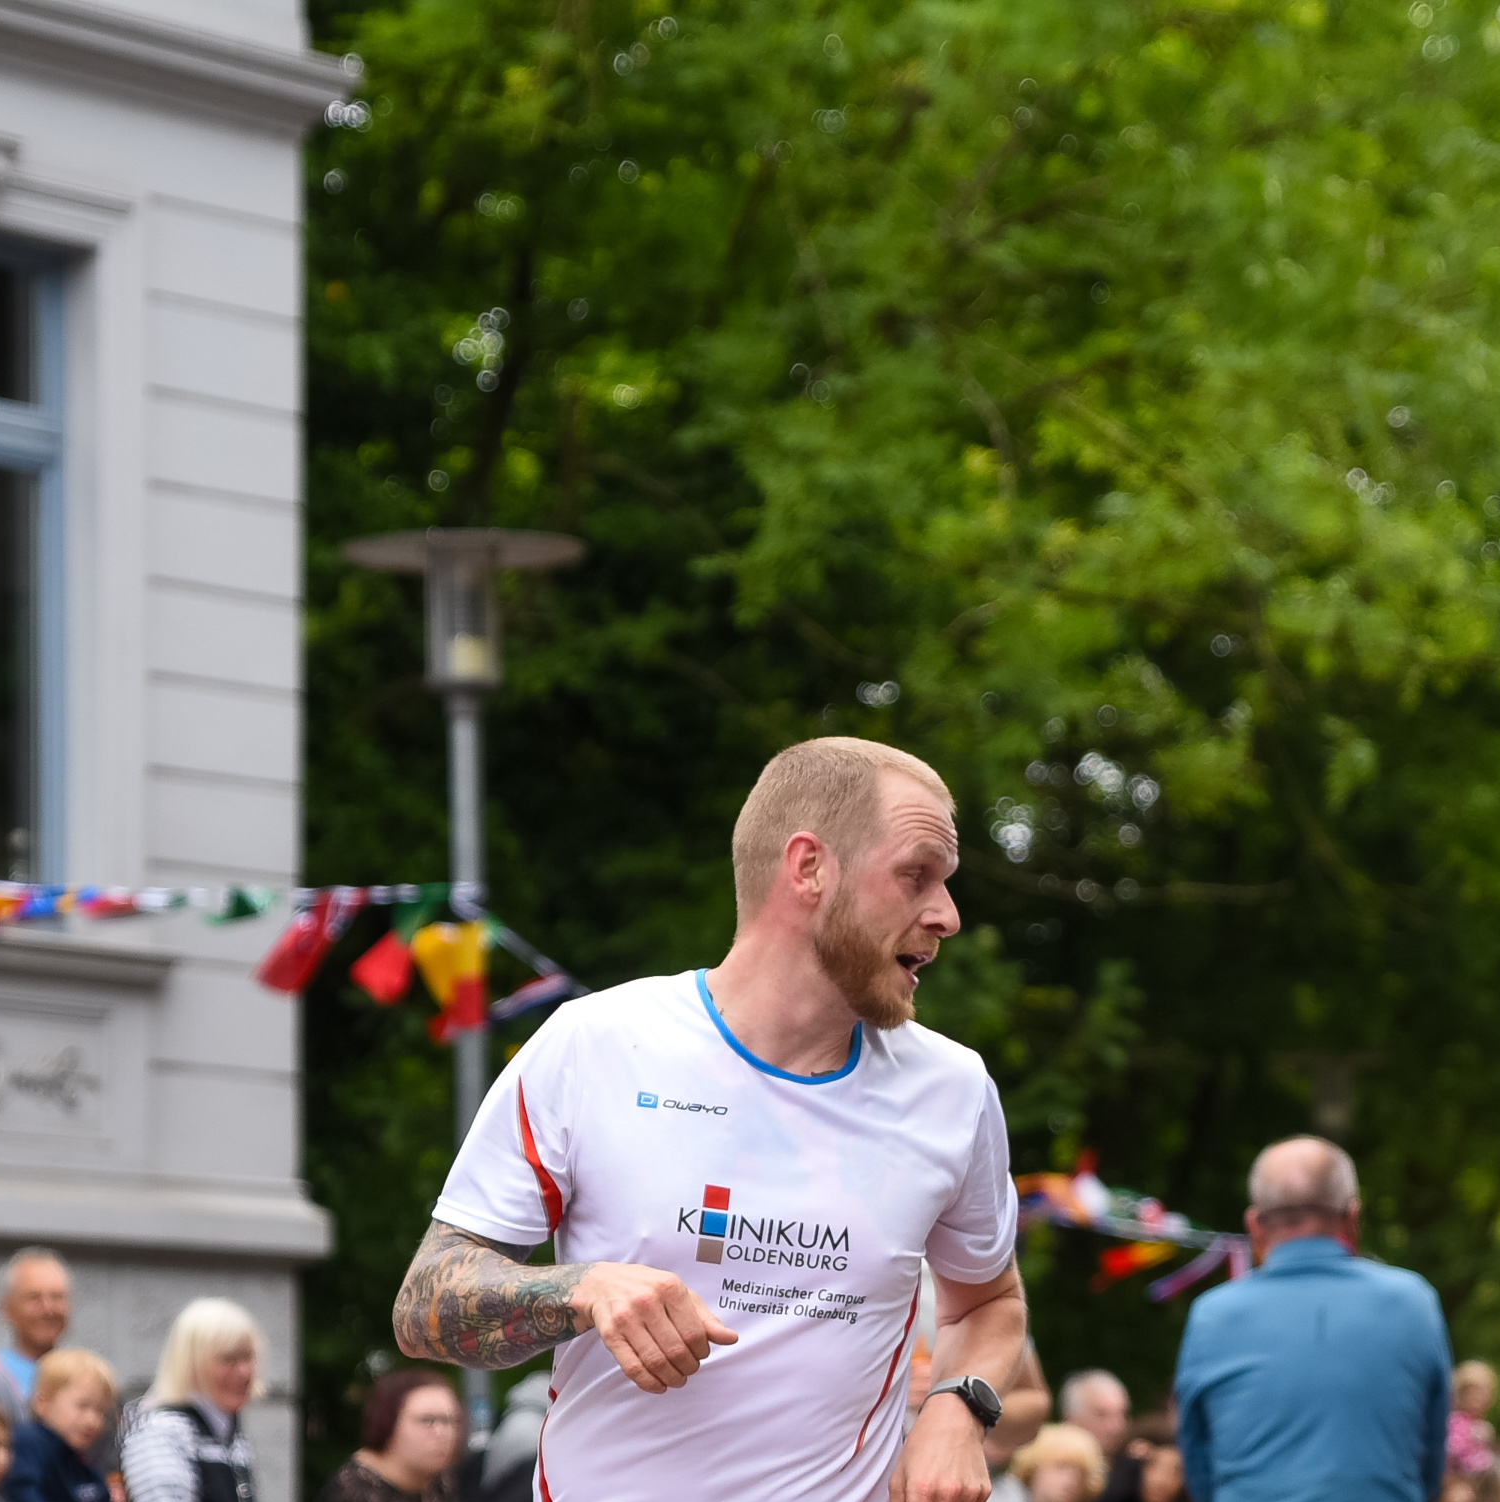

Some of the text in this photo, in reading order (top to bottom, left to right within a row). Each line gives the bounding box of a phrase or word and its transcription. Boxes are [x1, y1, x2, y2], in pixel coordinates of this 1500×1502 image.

[662, 1099, 729, 1116] owayo
[677, 1207, 850, 1253] KLINIKUM
[726, 1244, 848, 1272] OLDENBURG
[721, 1278, 867, 1308] Medizinischer Campus
[718, 1295, 859, 1325] Universität Oldenburg
